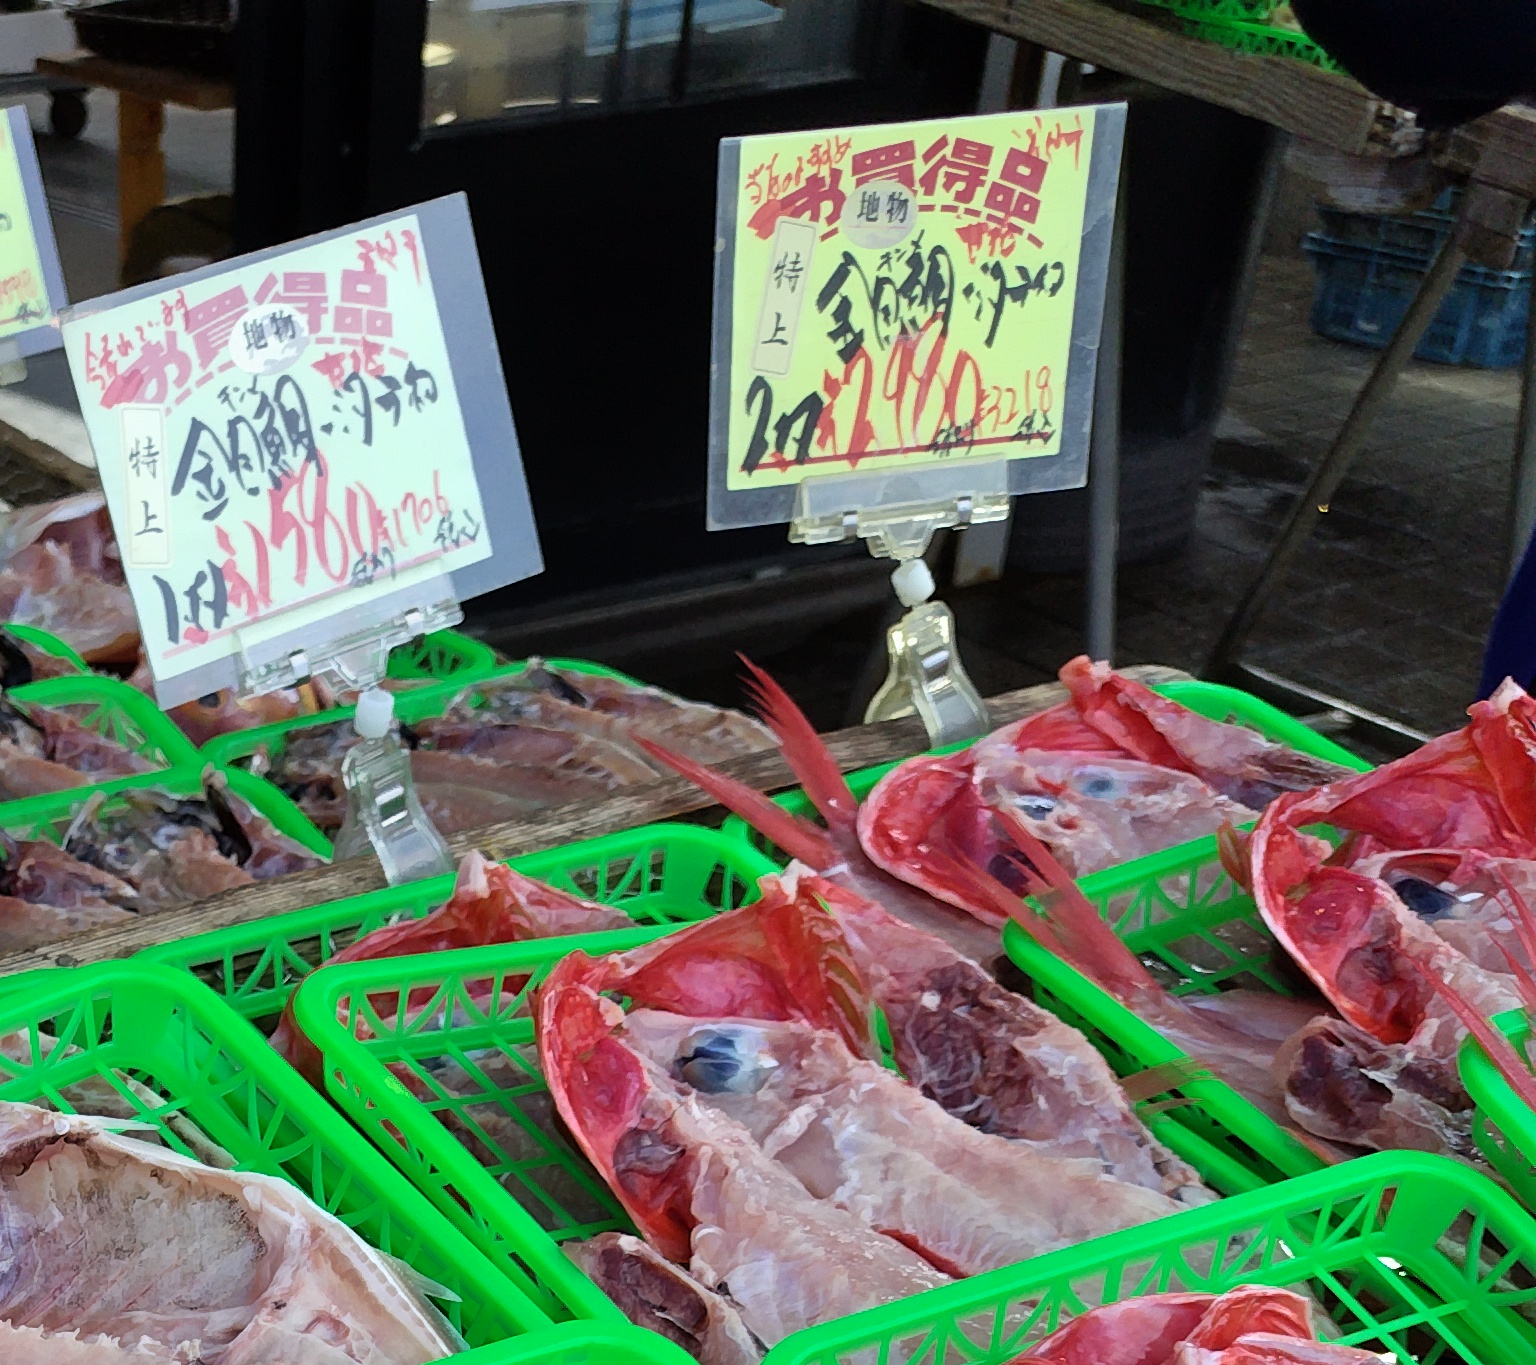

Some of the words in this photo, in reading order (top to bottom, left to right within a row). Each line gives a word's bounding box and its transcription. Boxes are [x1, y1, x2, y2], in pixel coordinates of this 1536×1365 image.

[857, 191, 909, 223] 地物
[243, 309, 296, 351] 地物
[761, 251, 804, 347] 特上
[128, 436, 164, 537] 特上
